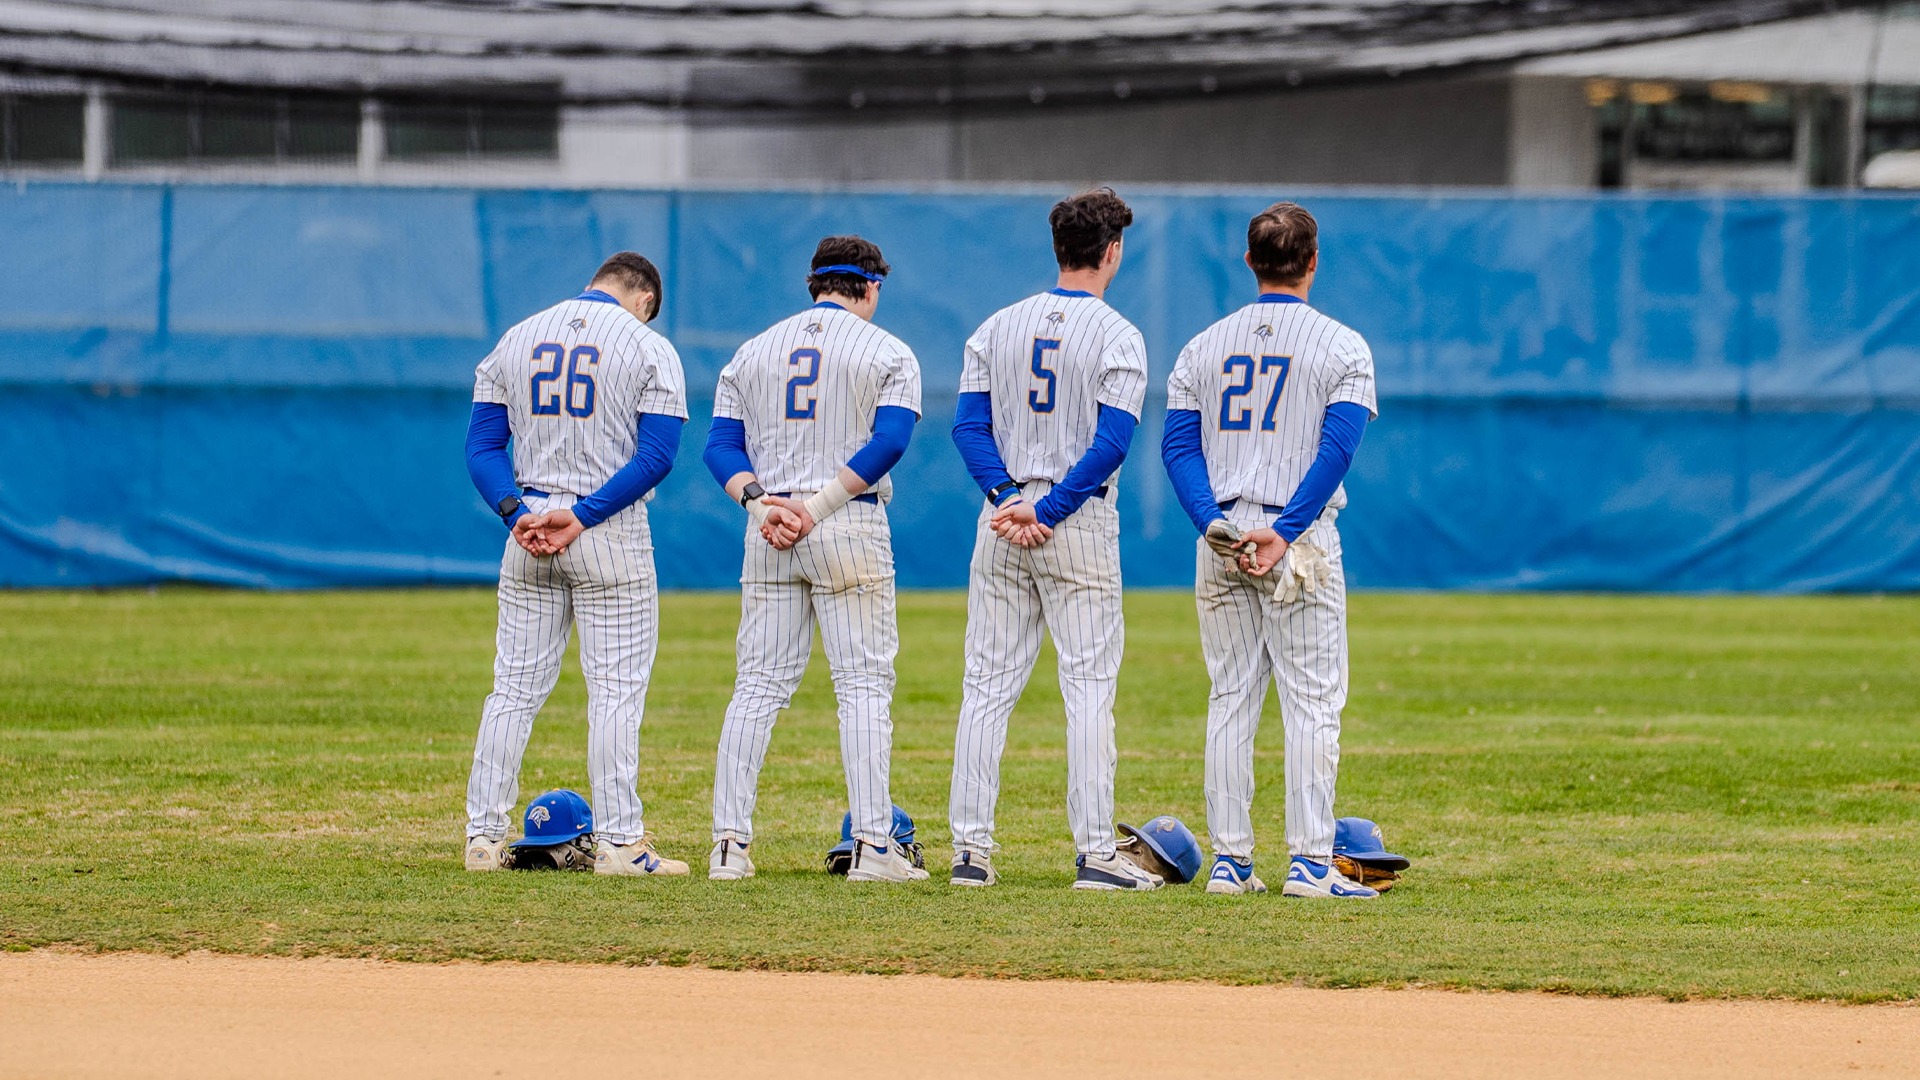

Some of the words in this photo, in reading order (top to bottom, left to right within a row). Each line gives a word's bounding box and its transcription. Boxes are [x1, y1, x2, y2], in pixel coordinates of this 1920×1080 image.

[529, 342, 602, 420] 26
[784, 347, 822, 421] 2
[1027, 336, 1062, 414] 5
[1218, 353, 1293, 432] 27
